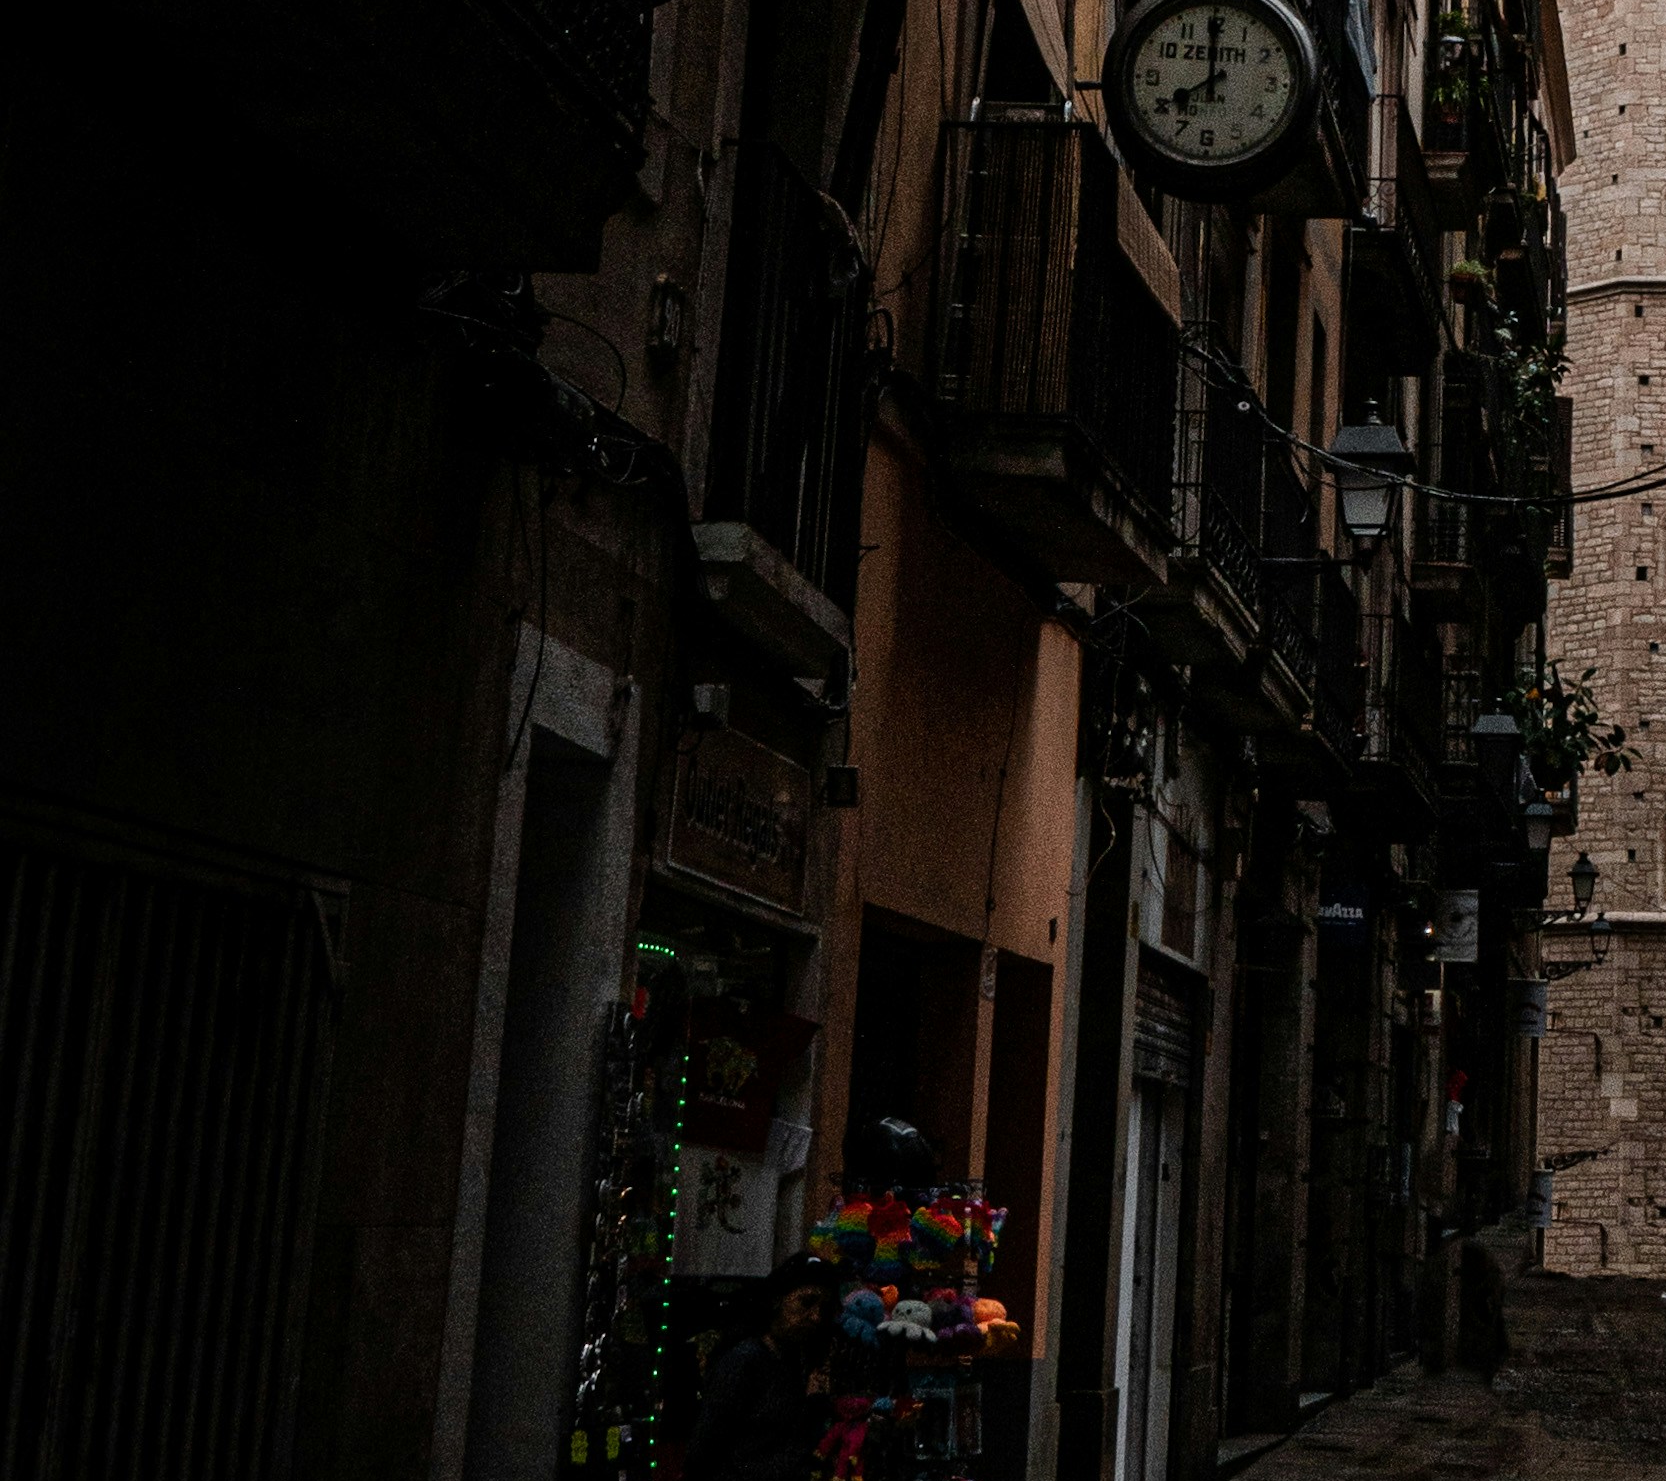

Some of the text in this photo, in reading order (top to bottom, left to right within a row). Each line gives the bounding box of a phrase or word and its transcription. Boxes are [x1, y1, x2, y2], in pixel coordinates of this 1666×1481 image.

[1180, 23, 1194, 40] 11
[1241, 27, 1248, 42] 1
[1159, 42, 1177, 59] 10
[1183, 45, 1246, 64] ZENITH
[1258, 48, 1271, 64] 2
[1145, 69, 1160, 86] 9
[1264, 76, 1278, 93] 3
[1154, 98, 1170, 114] 8
[1249, 104, 1265, 120] 4
[1174, 120, 1190, 136] 7
[1230, 123, 1243, 140] 5
[1200, 130, 1214, 147] 6
[1317, 902, 1364, 919] AVAZZA
